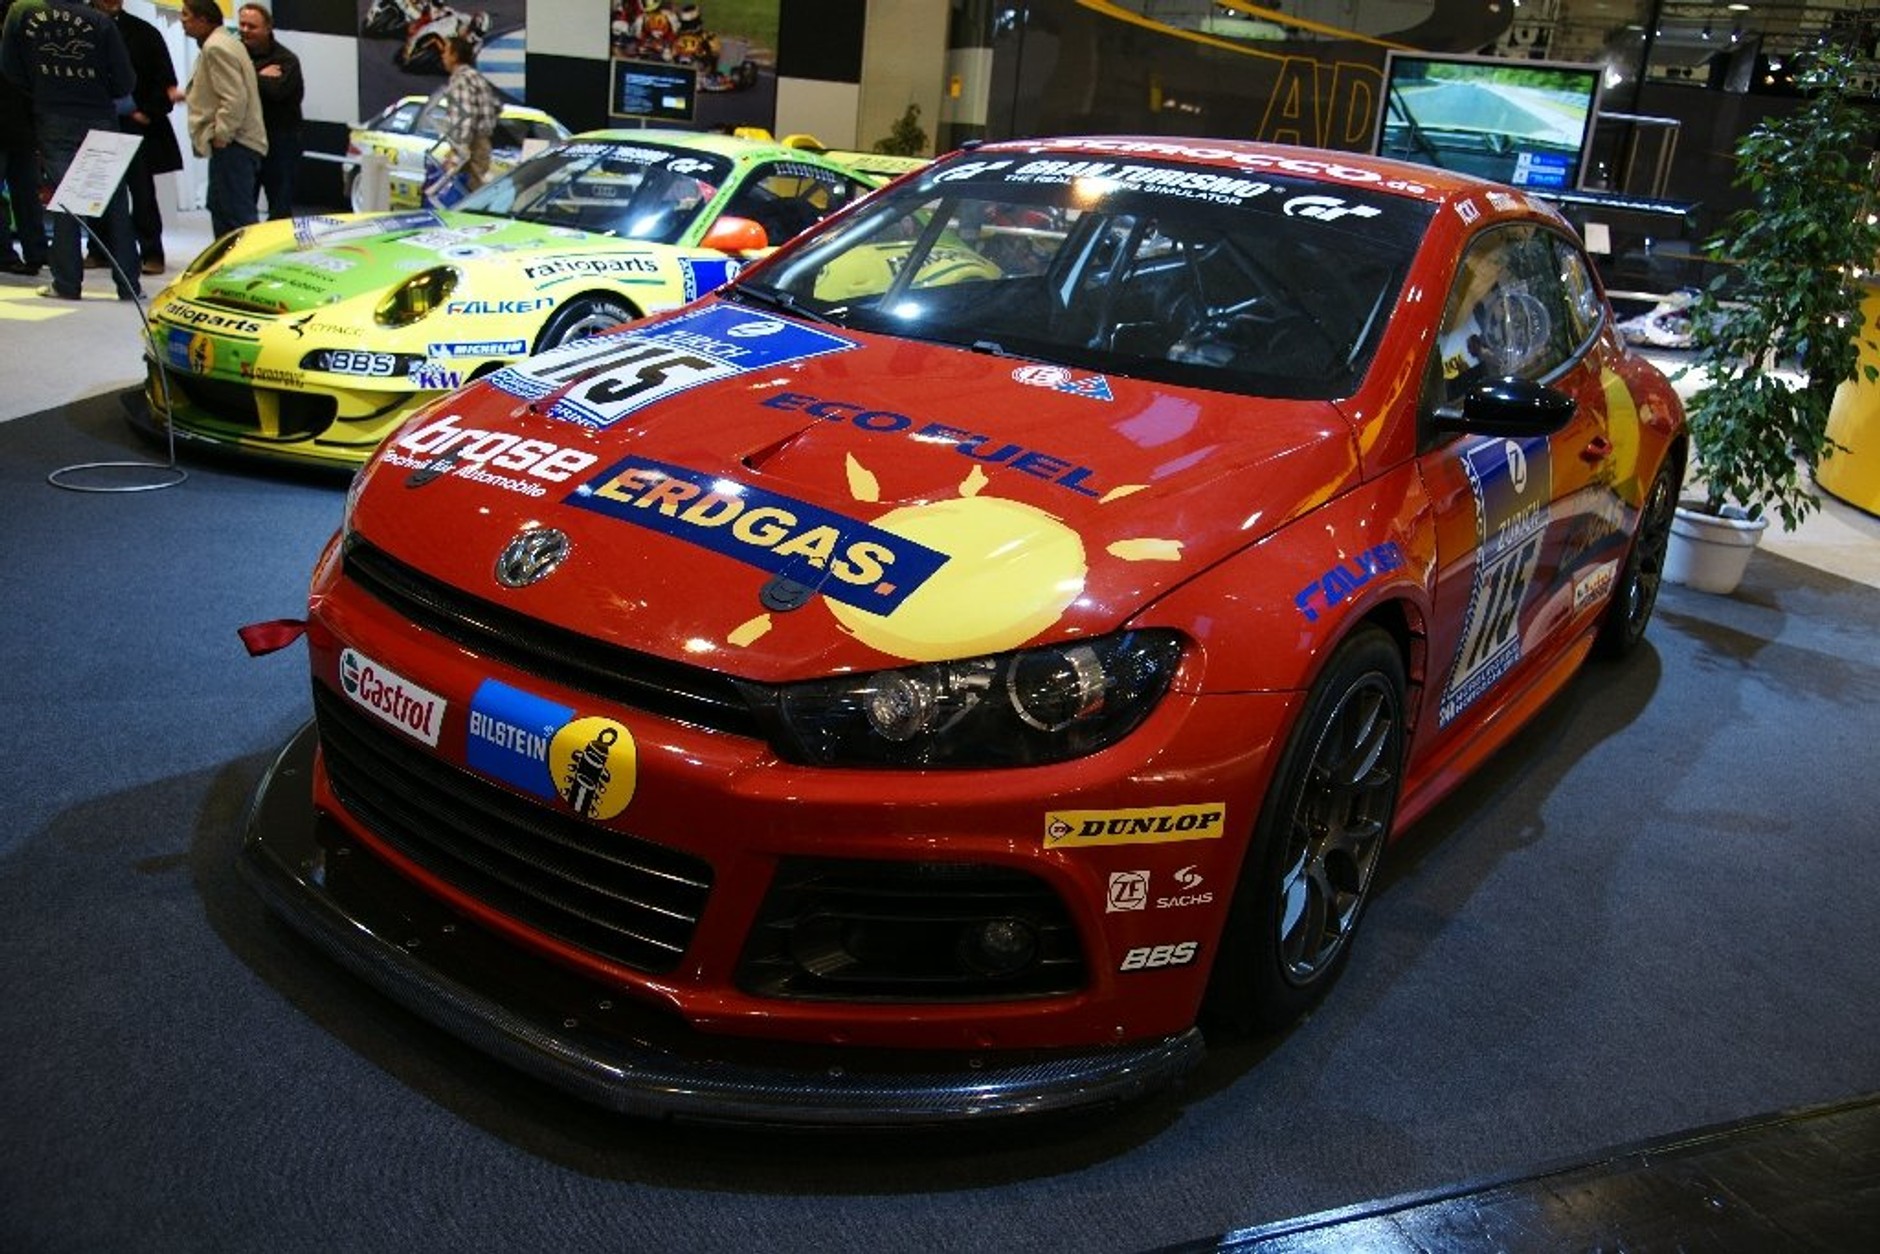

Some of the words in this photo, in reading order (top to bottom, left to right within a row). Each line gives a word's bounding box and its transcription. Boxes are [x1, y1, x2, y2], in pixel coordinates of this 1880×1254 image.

[1114, 165, 1272, 199] TURISMO
[1144, 184, 1243, 205] SIMULATOR
[524, 256, 660, 280] ratioparts
[166, 302, 261, 333] ratioparts
[448, 297, 555, 315] FALKEN
[453, 342, 522, 354] MICHELIN
[331, 352, 392, 374] BBS
[420, 371, 462, 389] KW
[398, 415, 598, 482] brose
[453, 464, 547, 498] Automobile
[358, 666, 435, 736] Castrol
[469, 710, 547, 762] BILSTEIN
[1078, 811, 1222, 837] DUNLOP
[1112, 880, 1146, 902] ZF
[1156, 892, 1214, 909] SACHS
[1120, 941, 1199, 971] BBS
